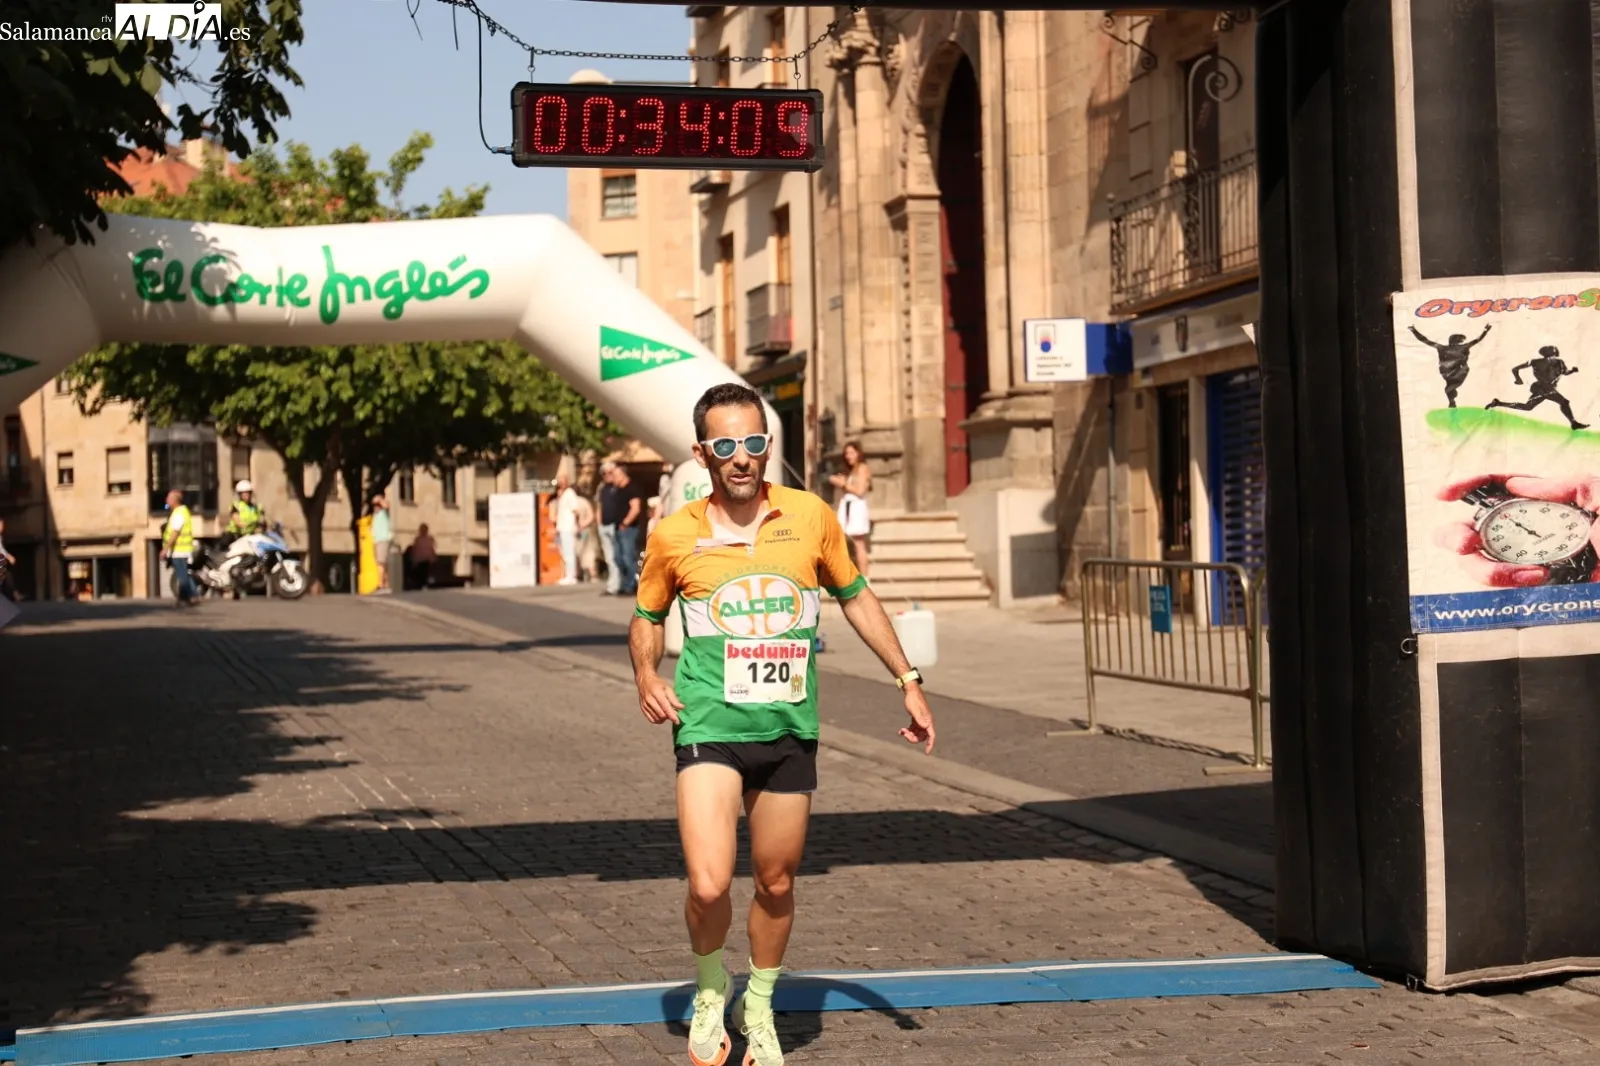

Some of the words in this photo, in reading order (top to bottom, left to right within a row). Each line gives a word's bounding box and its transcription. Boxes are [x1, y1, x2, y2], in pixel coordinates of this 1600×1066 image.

[533, 95, 809, 157] 00:34:09
[132, 247, 186, 303] El
[190, 253, 311, 308] Corte
[319, 244, 490, 325] Inglés
[719, 596, 795, 618] ALCER
[727, 643, 807, 659] bedunia
[747, 662, 790, 683] 120
